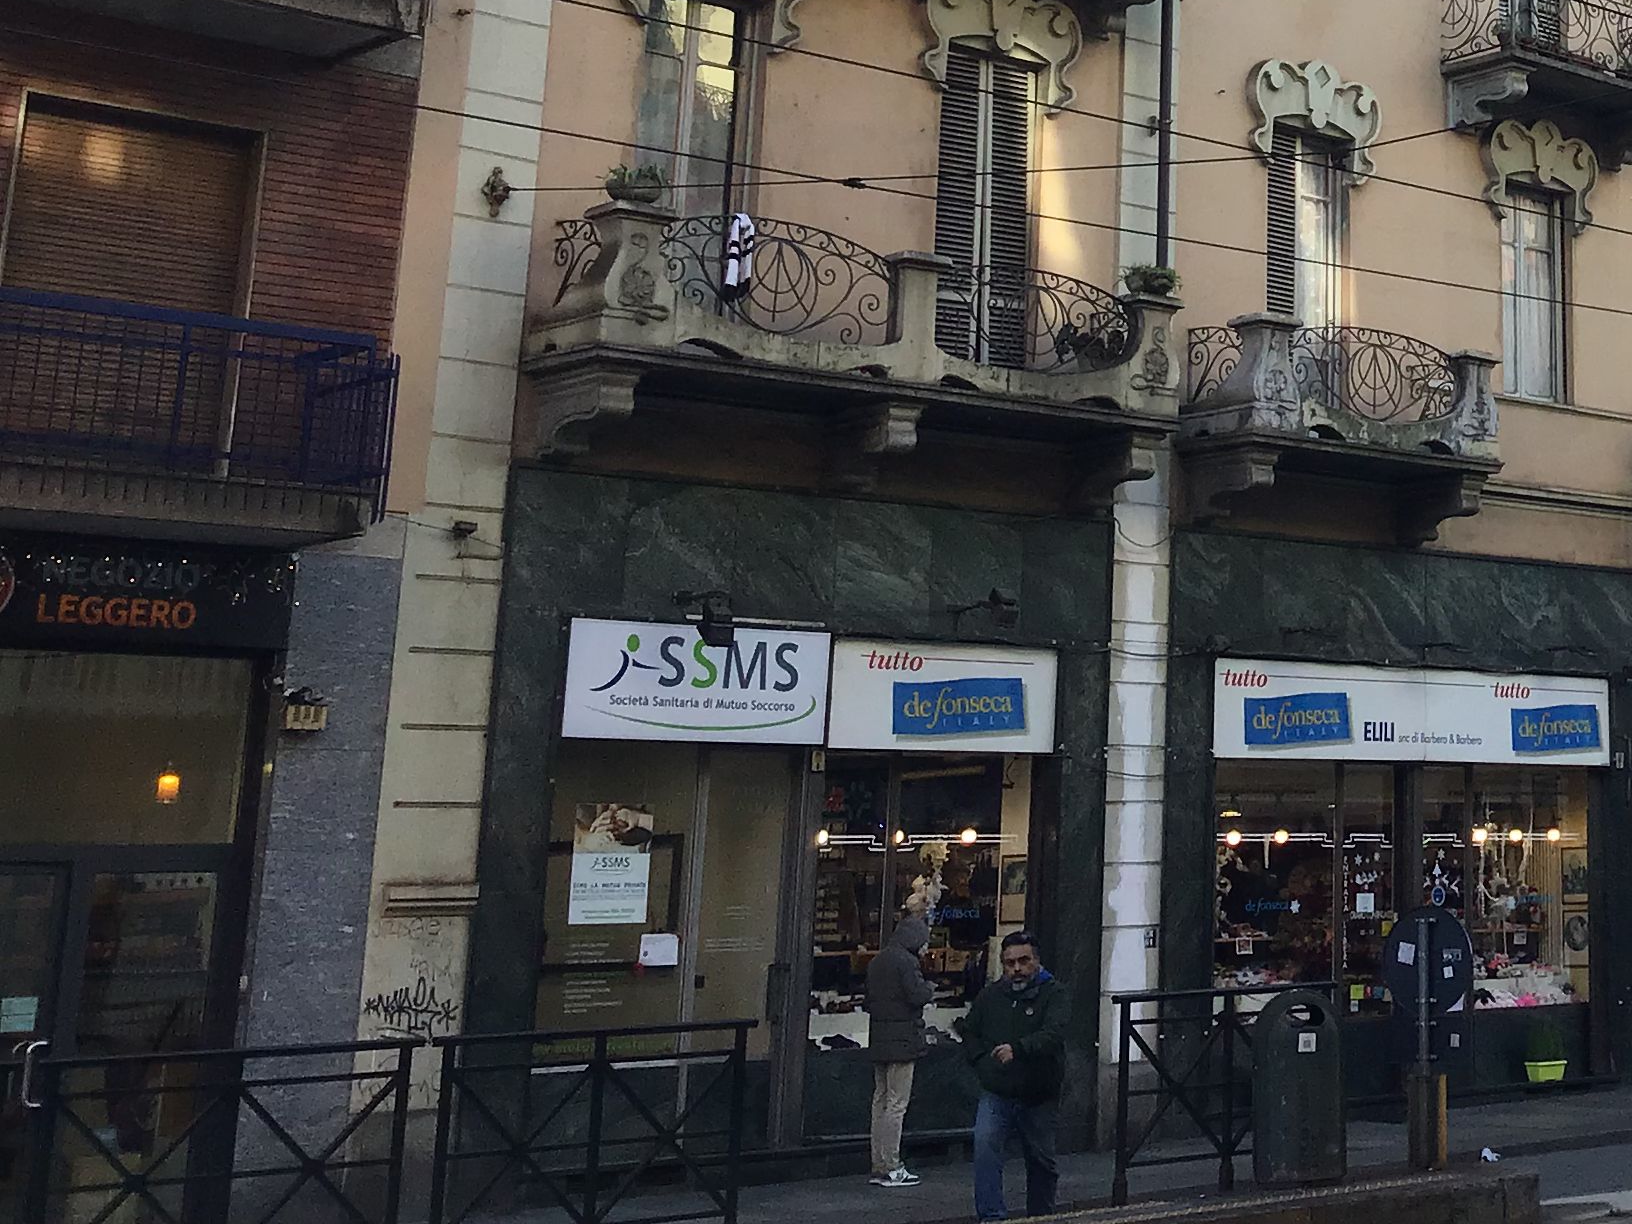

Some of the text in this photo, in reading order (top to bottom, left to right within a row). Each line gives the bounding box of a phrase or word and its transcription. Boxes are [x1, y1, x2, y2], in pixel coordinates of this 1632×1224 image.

[37, 594, 196, 628] LEGGERO
[868, 650, 924, 671] tutto
[1224, 669, 1268, 688] tutto
[1494, 682, 1530, 699] tutto
[609, 695, 795, 712] Società Sanitaria di Mutuo Soccorso
[1364, 722, 1395, 742] ELILI
[1420, 732, 1447, 744] Barbero
[1456, 733, 1482, 745] Barbero
